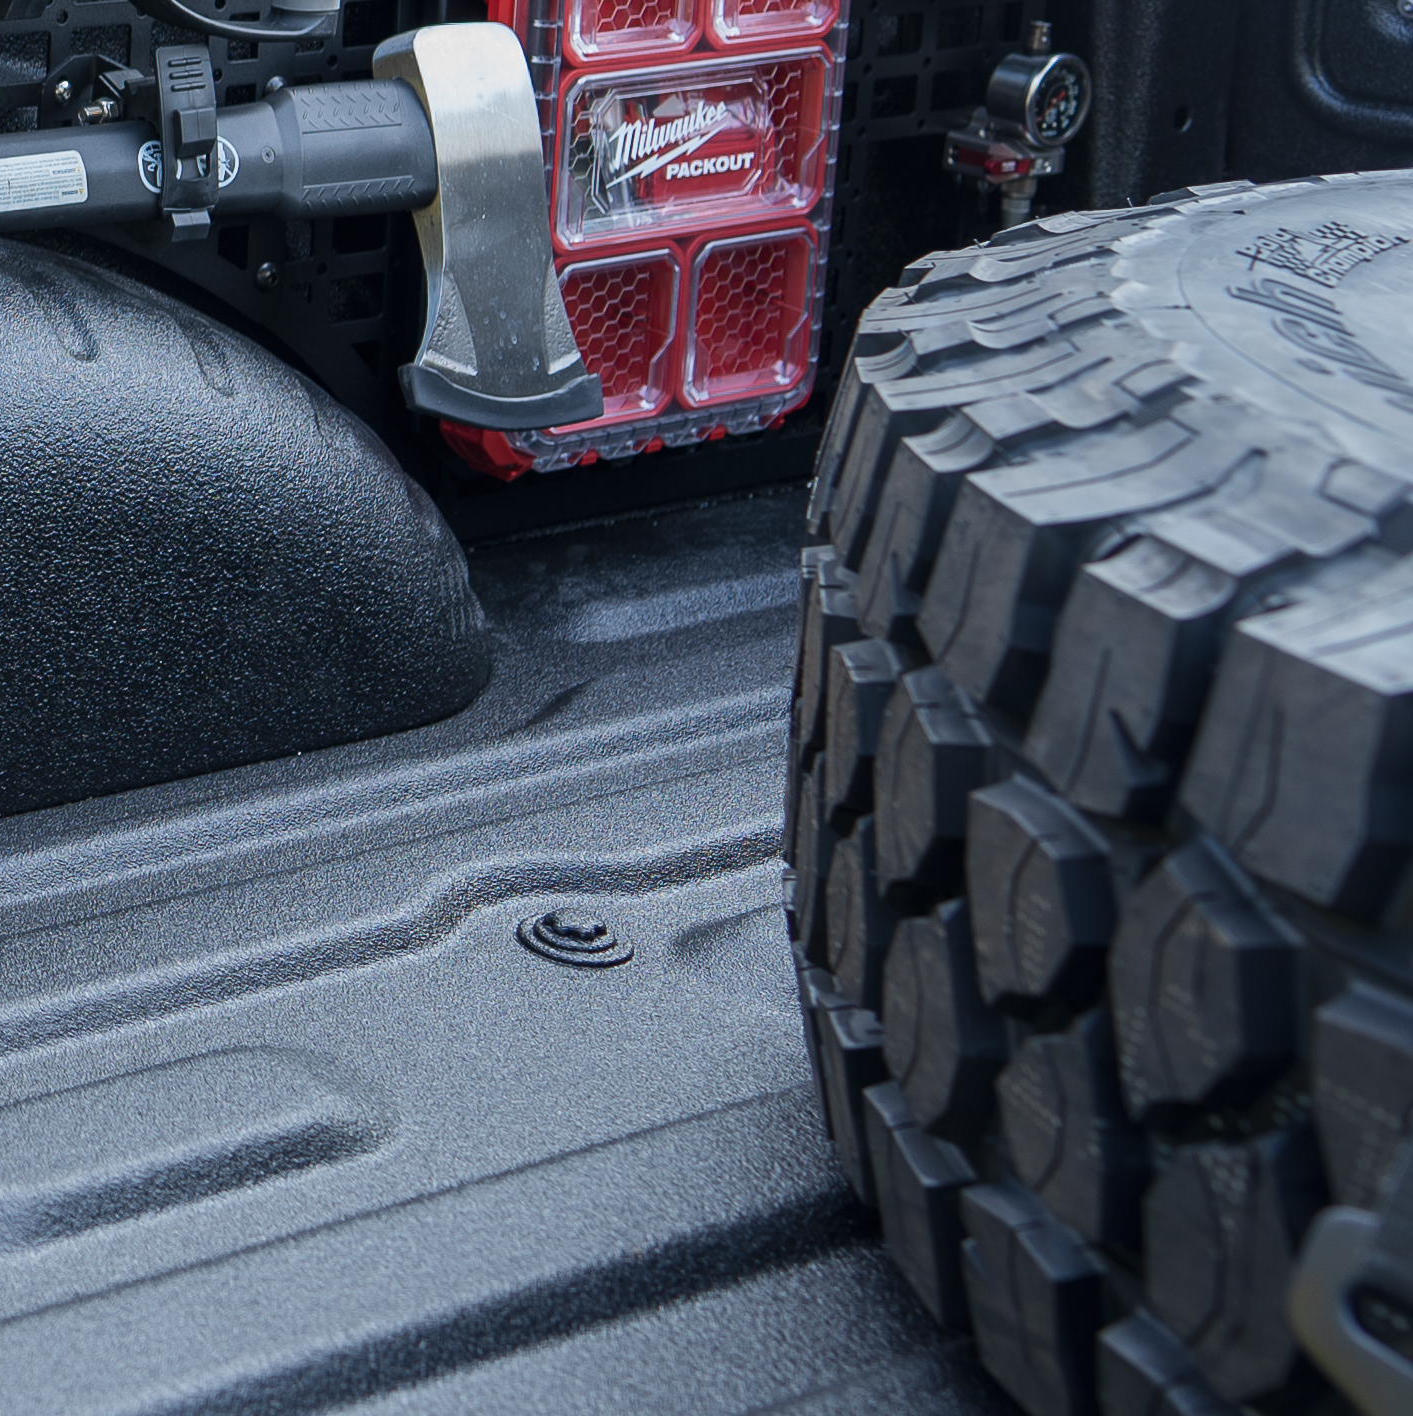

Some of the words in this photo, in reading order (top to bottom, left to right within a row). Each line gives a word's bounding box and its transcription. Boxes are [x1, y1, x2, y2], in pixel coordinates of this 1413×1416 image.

[608, 99, 728, 174] Milwaukee
[666, 152, 755, 181] PACKOUT
[1304, 235, 1411, 289] Champion
